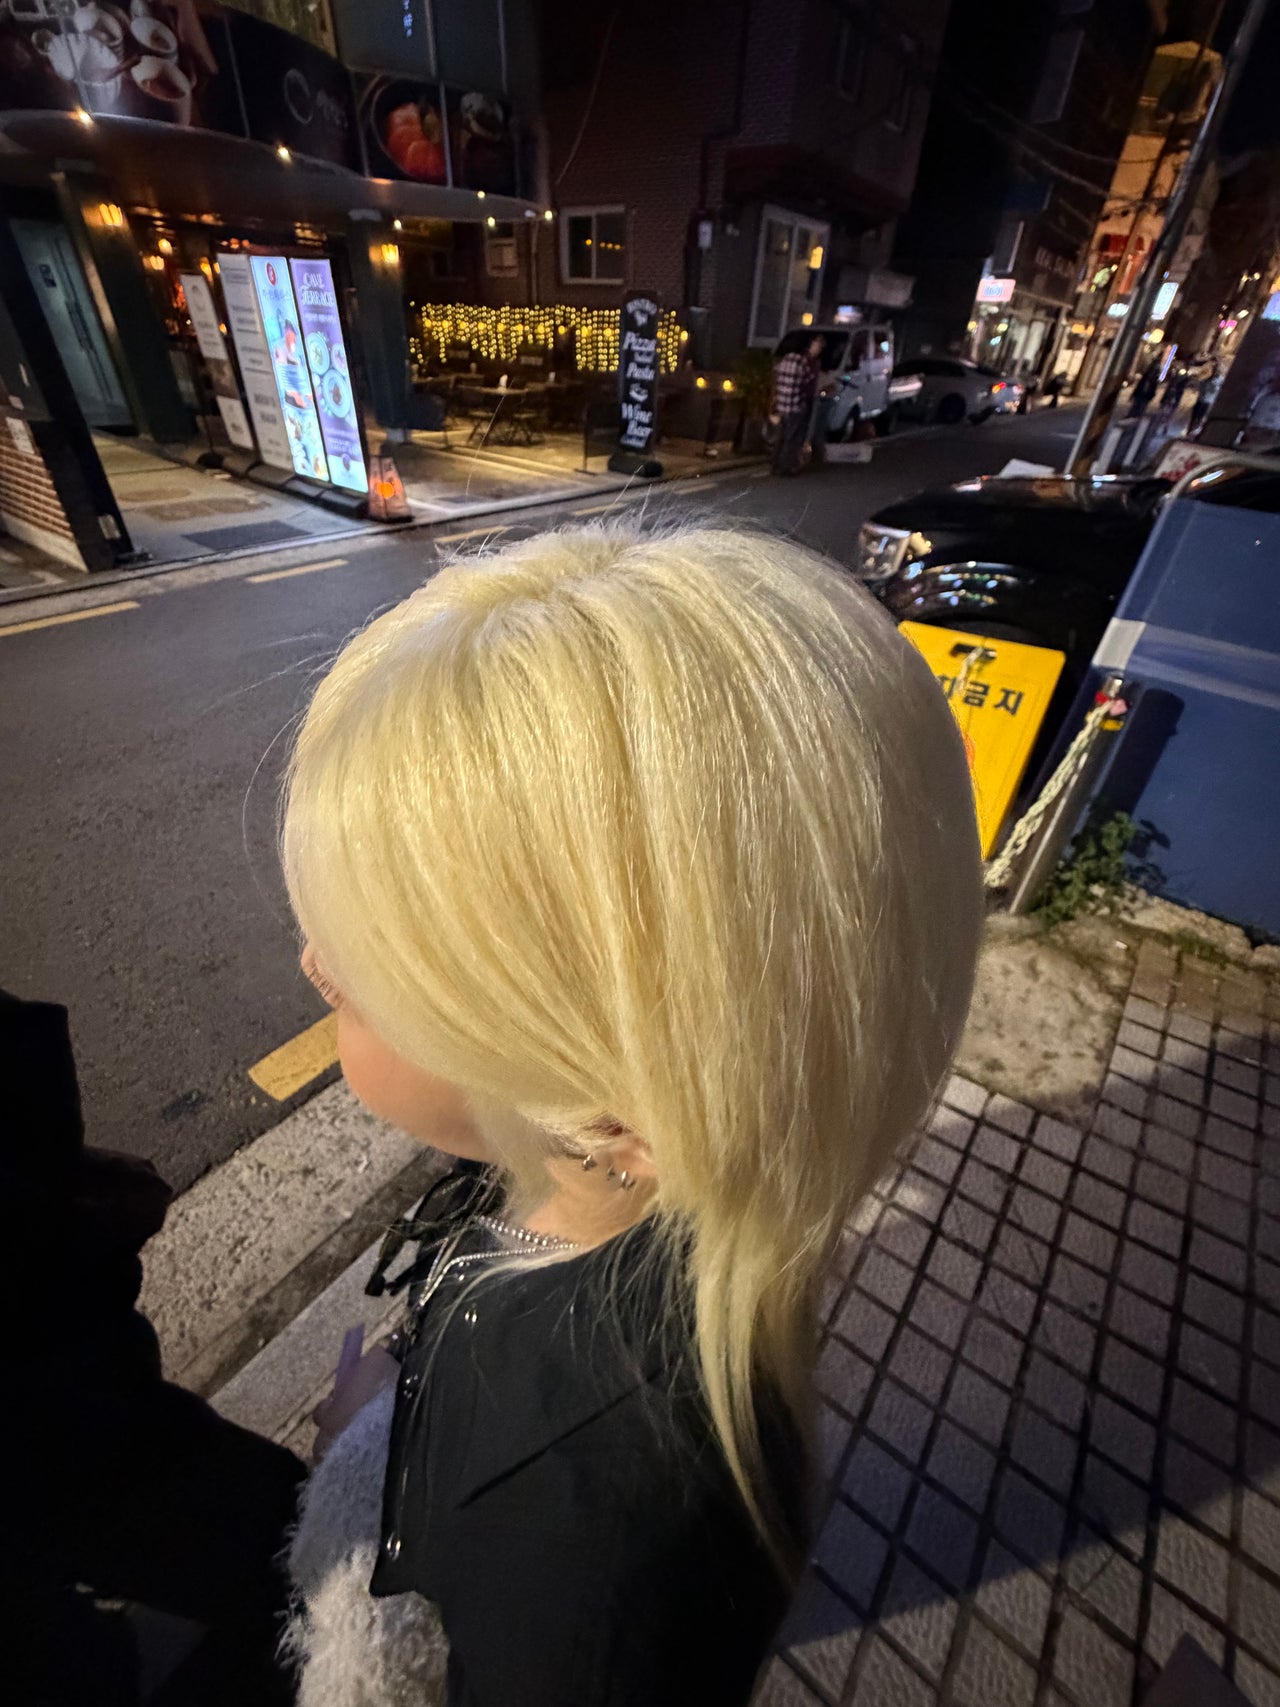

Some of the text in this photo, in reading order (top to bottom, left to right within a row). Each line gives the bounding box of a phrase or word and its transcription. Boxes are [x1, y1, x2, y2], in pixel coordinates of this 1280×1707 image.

[622, 331, 657, 351] Pizza
[626, 362, 656, 380] Pasta
[621, 402, 653, 424] Wine
